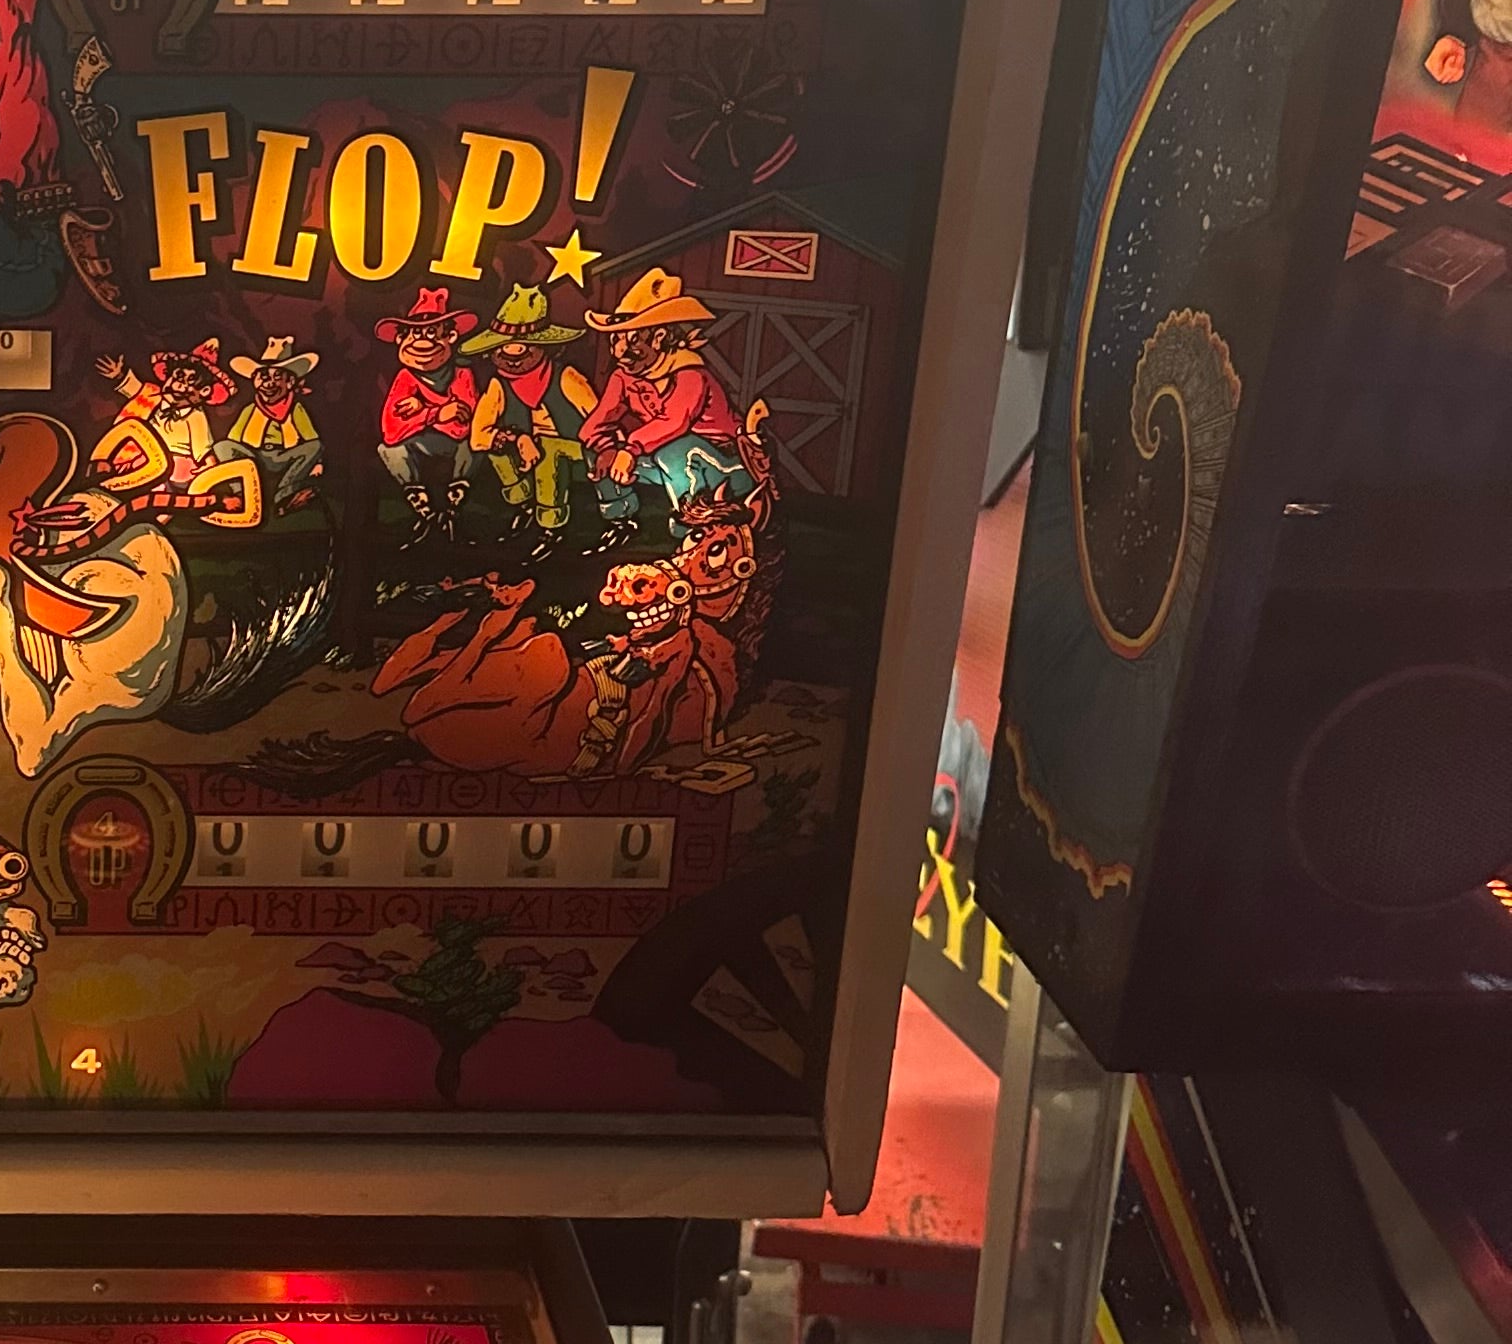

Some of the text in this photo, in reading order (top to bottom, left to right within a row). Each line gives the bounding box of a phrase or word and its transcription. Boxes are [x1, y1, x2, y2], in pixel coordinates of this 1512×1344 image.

[136, 65, 636, 288] FLOP!
[89, 845, 127, 887] UP
[68, 1046, 104, 1075] 4
